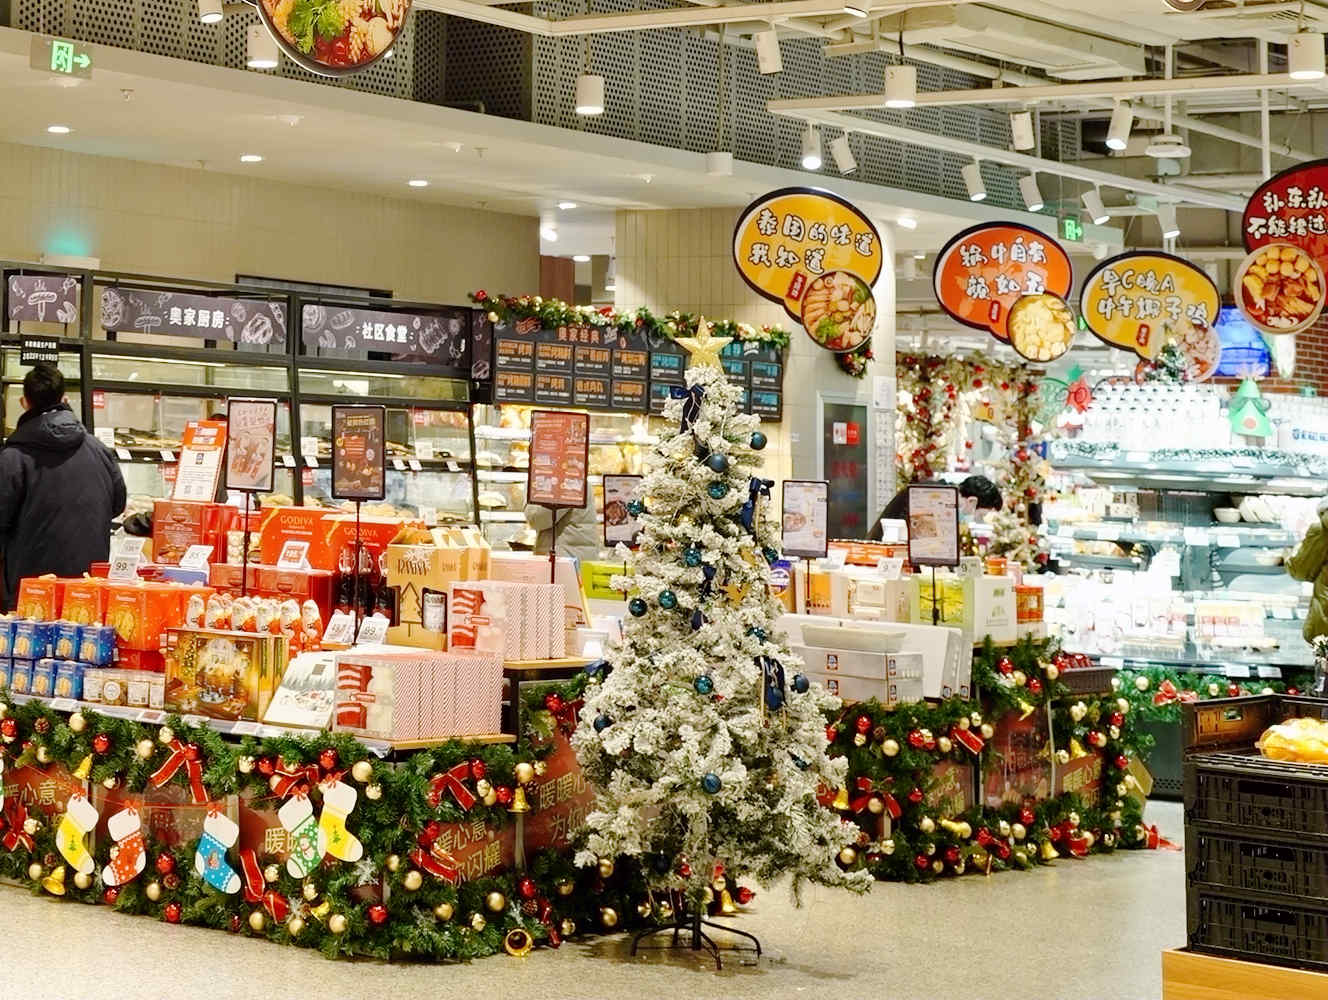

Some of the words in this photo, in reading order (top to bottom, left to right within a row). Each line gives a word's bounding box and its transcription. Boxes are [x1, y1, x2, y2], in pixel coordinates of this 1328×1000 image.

[757, 208, 874, 257] 泰国的味道
[748, 242, 825, 275] 我知道
[960, 237, 1048, 267] 锅中自有
[1101, 269, 1175, 296] 早C晚A
[169, 307, 226, 331] 奥家厨房
[362, 321, 409, 344] 社区食堂
[280, 514, 313, 526] GODIVA
